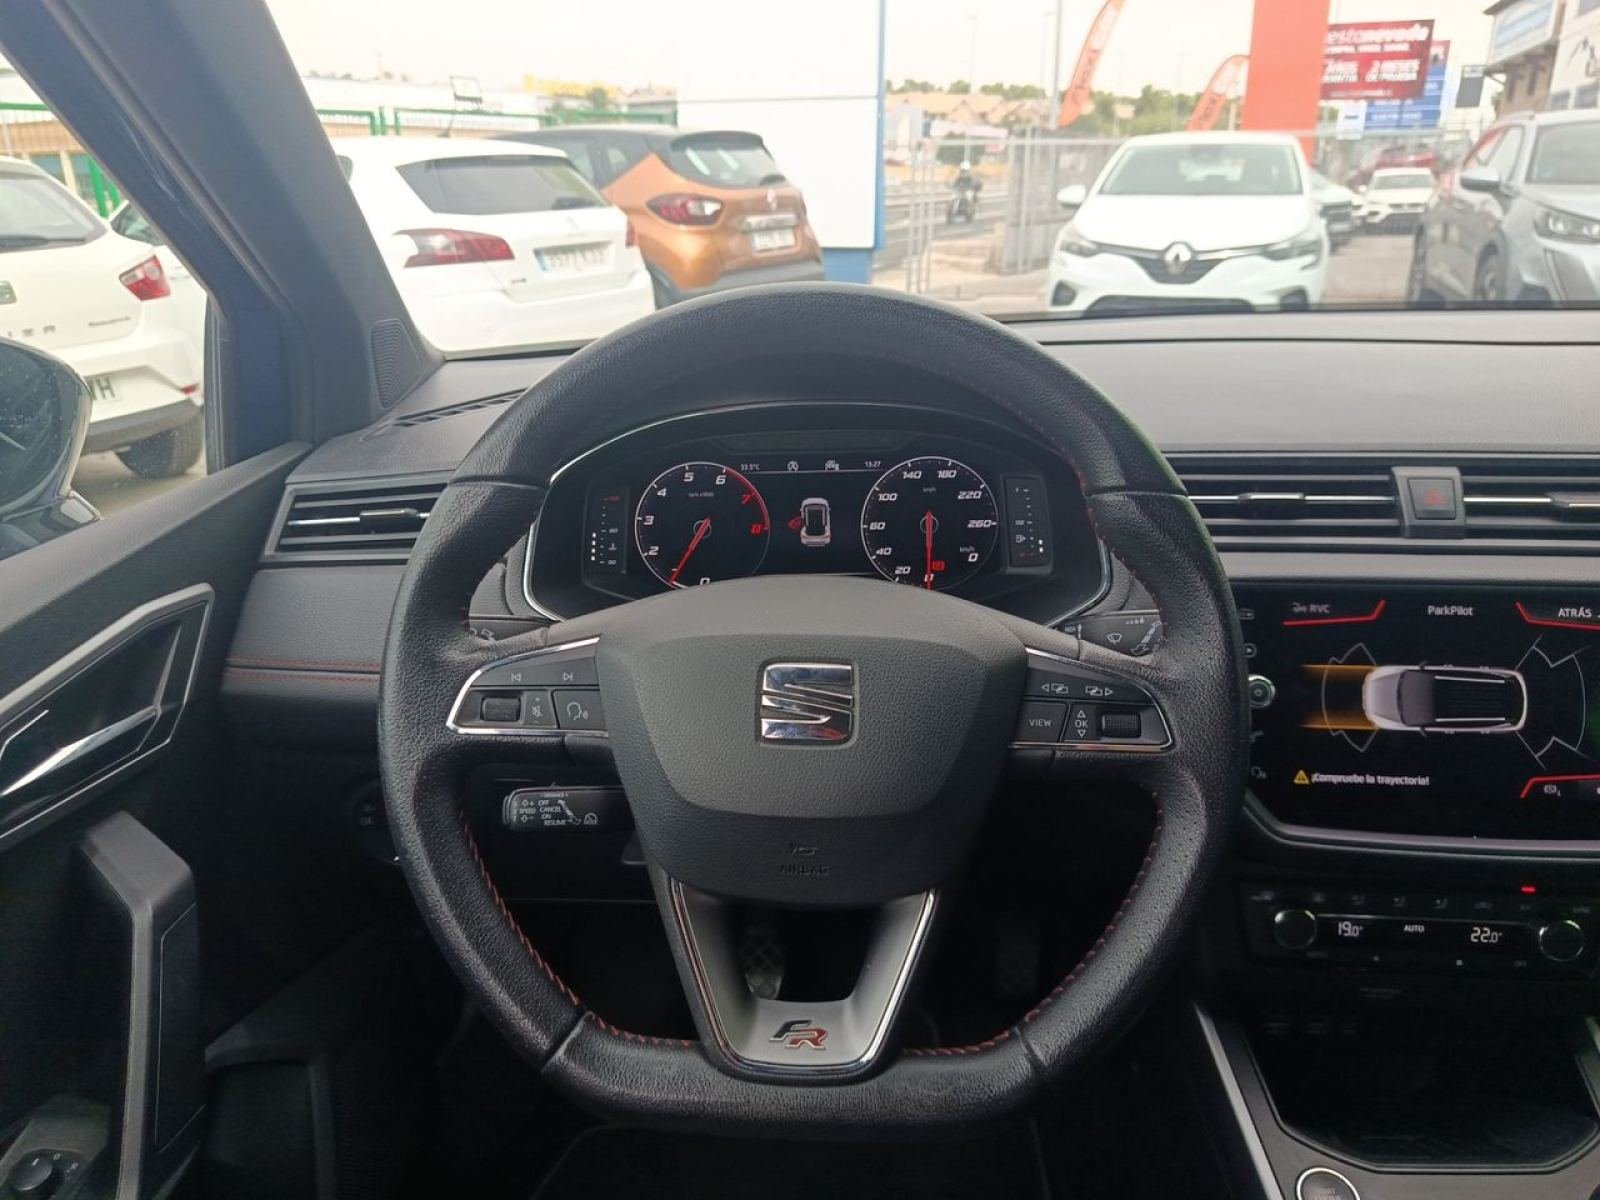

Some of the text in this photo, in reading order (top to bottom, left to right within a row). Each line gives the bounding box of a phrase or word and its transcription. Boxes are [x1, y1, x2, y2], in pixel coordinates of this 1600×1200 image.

[683, 472, 694, 482] 5
[903, 470, 922, 479] 140
[937, 469, 957, 479] 180
[715, 475, 726, 485] 6
[657, 488, 667, 497] 4
[878, 493, 898, 502] 100
[957, 490, 982, 500] 220
[742, 495, 751, 505] 7
[643, 515, 654, 526] 3
[967, 519, 992, 529] 260
[751, 524, 763, 534] 8
[648, 546, 659, 556] 2
[876, 547, 892, 556] 40
[968, 552, 979, 562] 0
[895, 566, 911, 575] 20
[1309, 604, 1330, 613] RVC
[1427, 605, 1473, 616] ParkPilot
[1558, 606, 1592, 618] ATRÁS
[1029, 718, 1052, 727] VIEW
[1074, 719, 1089, 729] OK
[1365, 774, 1376, 784] la
[1377, 776, 1430, 786] trayectoria!
[1403, 924, 1425, 933] AUTO
[768, 1020, 828, 1051] FR
